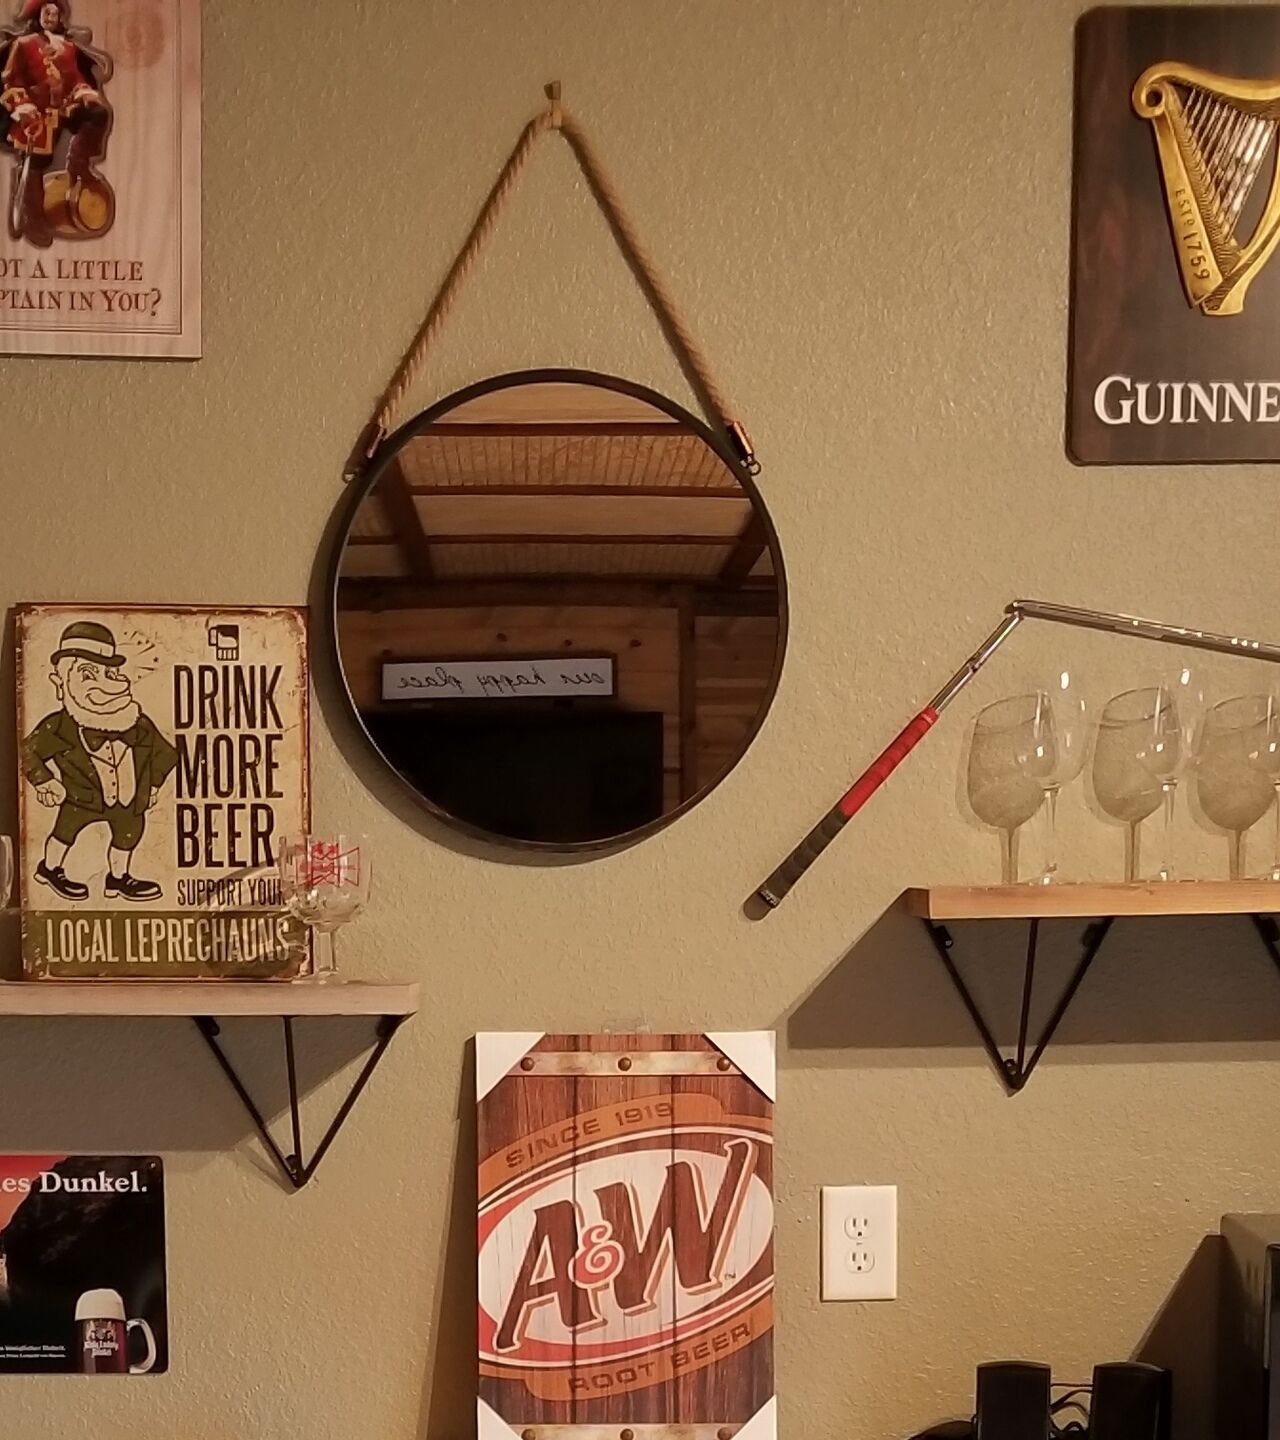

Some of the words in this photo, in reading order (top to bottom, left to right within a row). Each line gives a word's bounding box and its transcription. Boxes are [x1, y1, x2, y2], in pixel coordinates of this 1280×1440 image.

[31, 258, 48, 279] A
[57, 258, 144, 281] LITTLE
[1183, 231, 1211, 280] 1759
[69, 290, 94, 312] IN
[100, 287, 163, 317] YOU?
[173, 664, 284, 730] DRINK
[174, 733, 284, 799] MORE
[176, 802, 275, 869] BEER
[177, 878, 243, 907] SUPPORT
[46, 917, 121, 963] LOCAL
[124, 917, 289, 964] LEPRECHAUNS
[504, 1117, 602, 1170] SINCE
[615, 1101, 673, 1128] 1919
[38, 1169, 149, 1194] Dunkel.
[492, 1136, 760, 1355] A&W
[567, 1361, 656, 1394] ROOT
[671, 1322, 751, 1370] BEER
